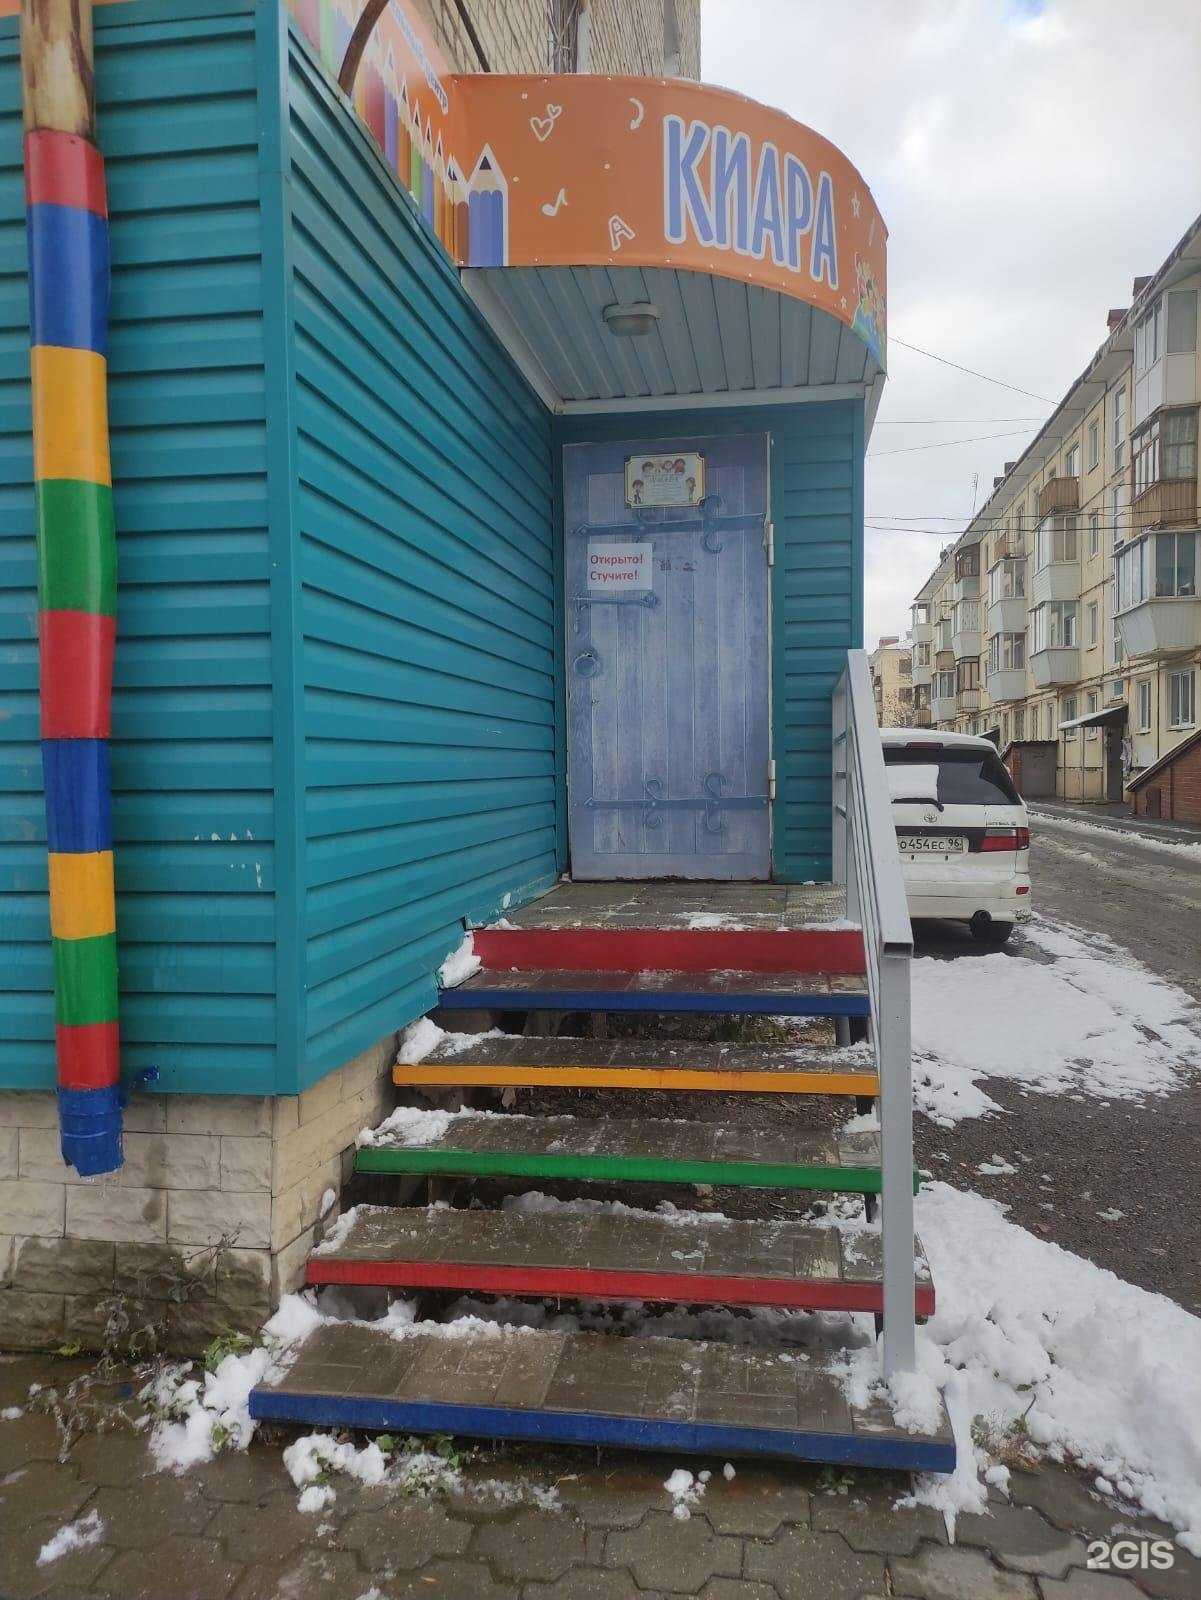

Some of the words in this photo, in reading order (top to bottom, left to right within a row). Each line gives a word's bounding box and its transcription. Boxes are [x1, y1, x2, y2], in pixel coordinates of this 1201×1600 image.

[663, 114, 839, 291] КИАРА
[590, 553, 643, 566] Открыто!
[590, 570, 638, 583] Стучите!
